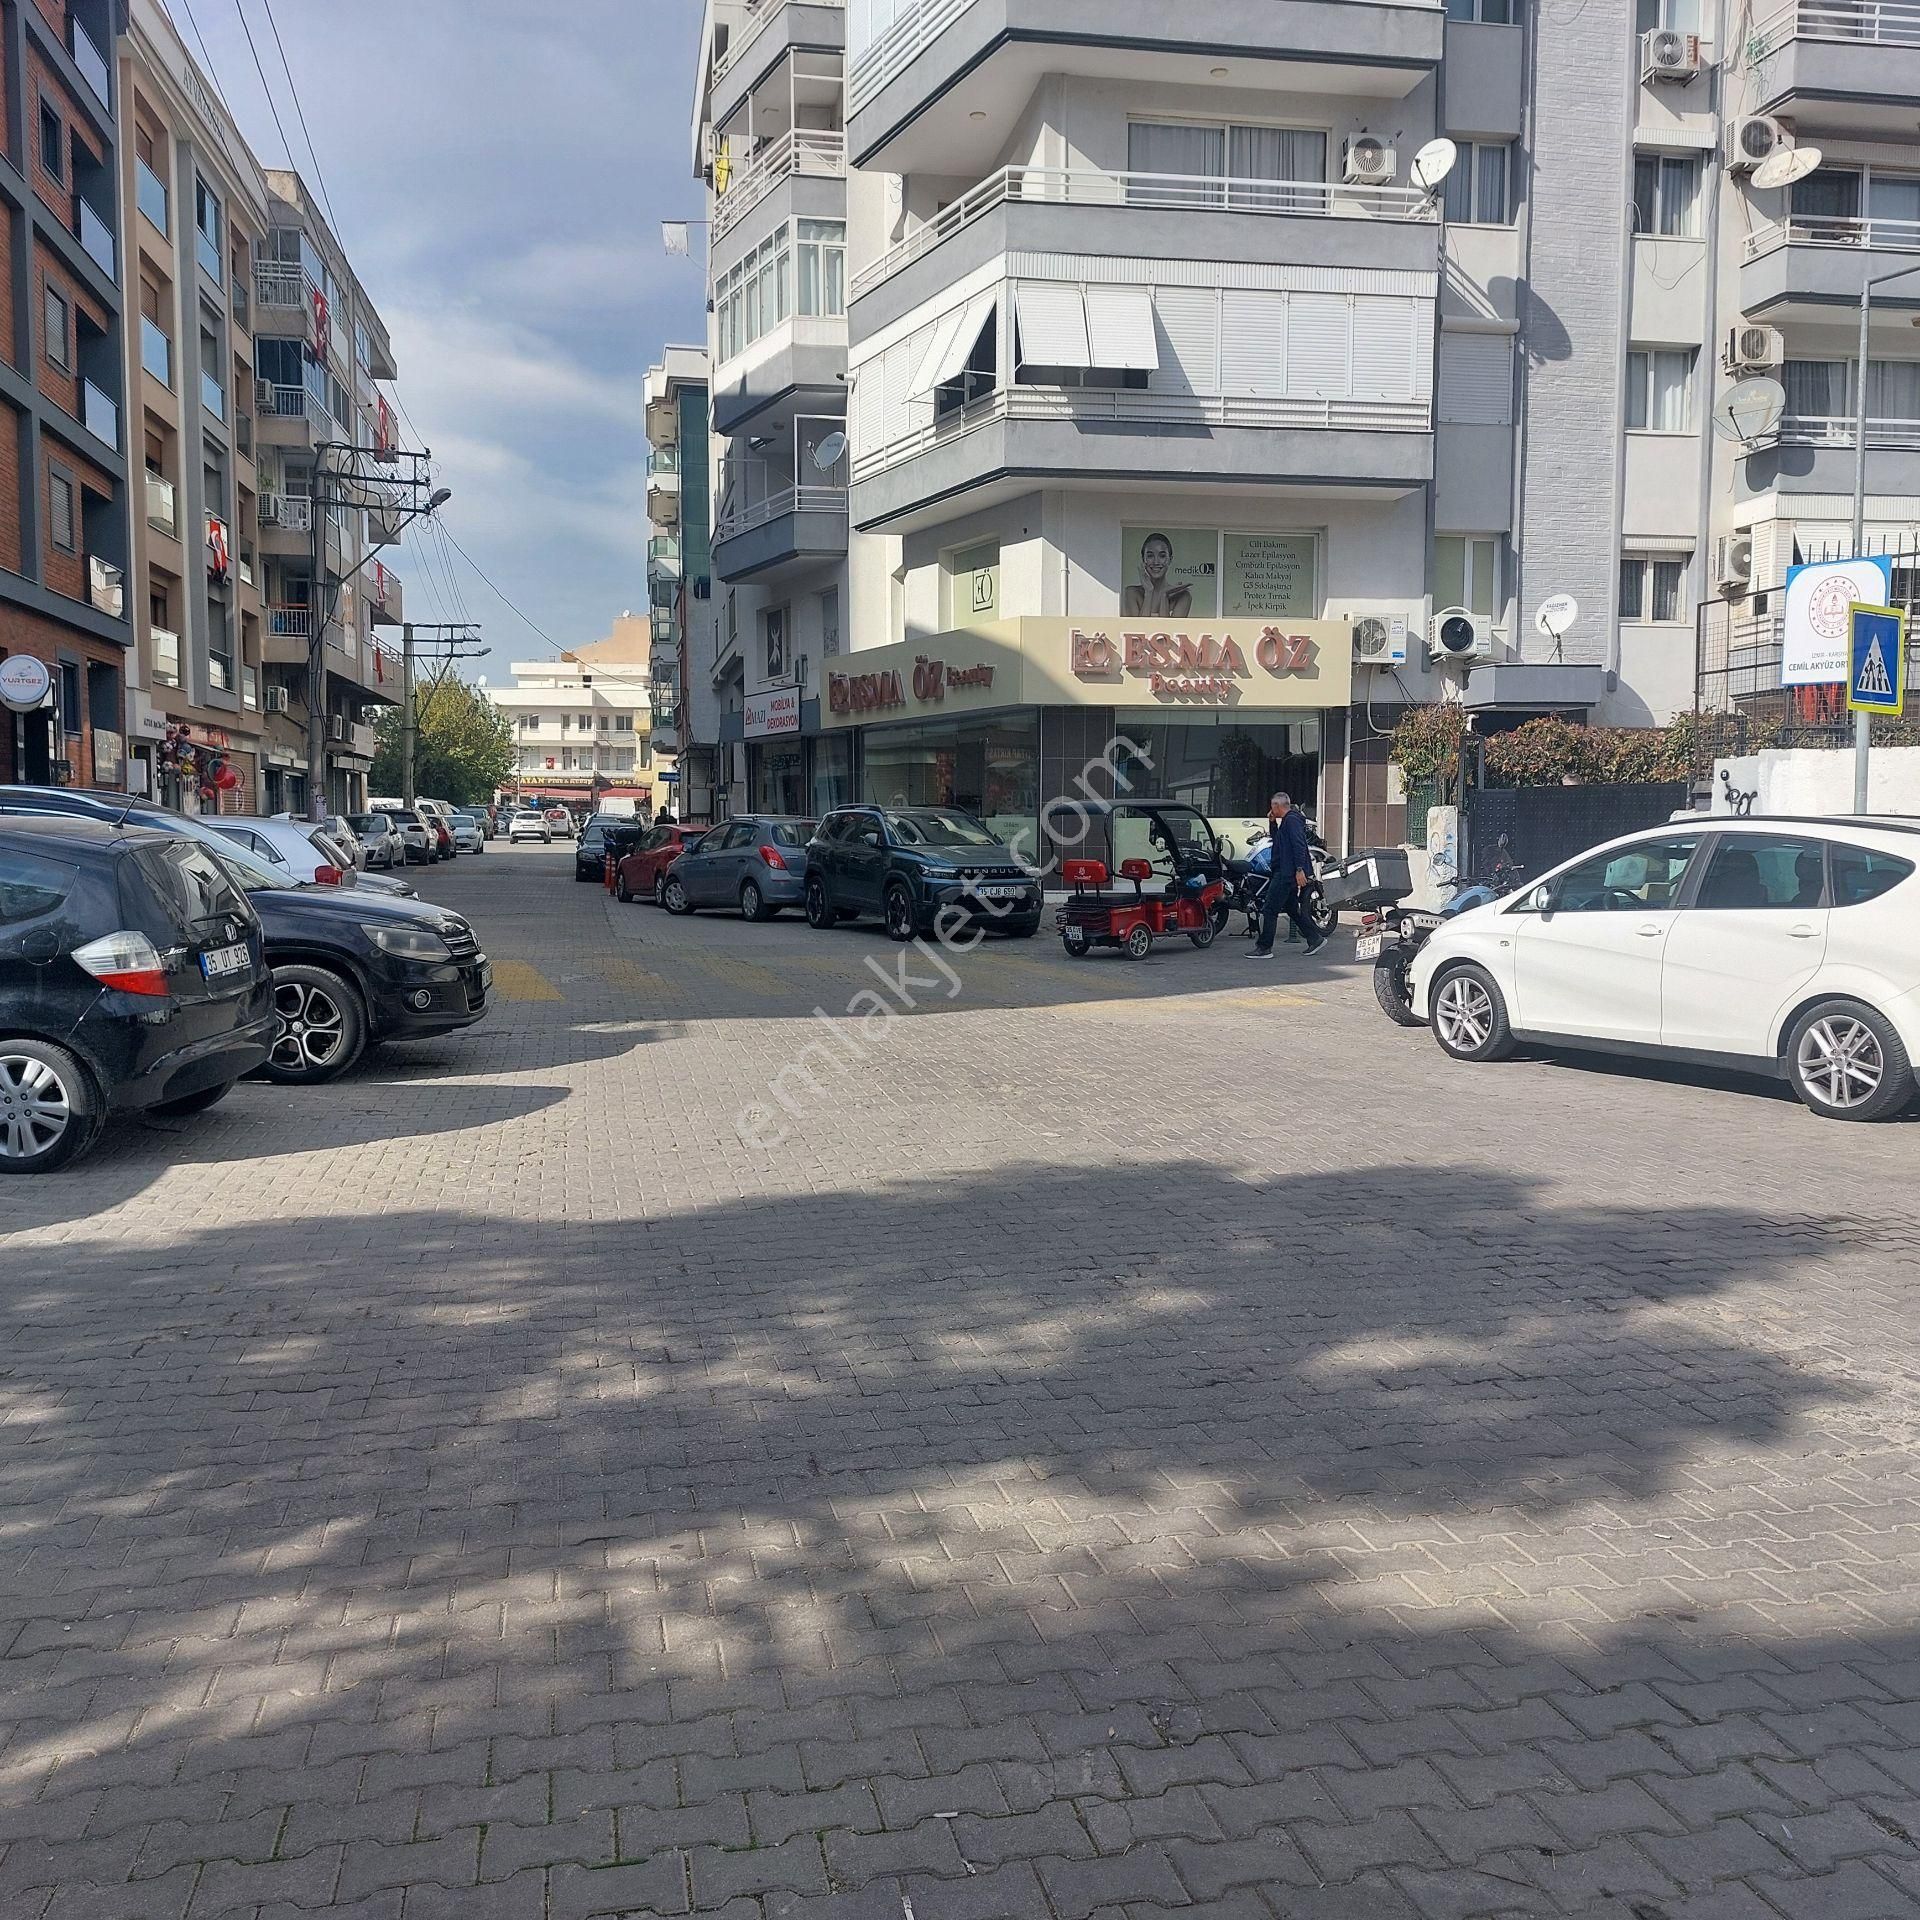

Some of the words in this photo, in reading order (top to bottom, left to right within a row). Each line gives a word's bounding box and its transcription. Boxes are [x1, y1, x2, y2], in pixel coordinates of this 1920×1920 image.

[1262, 551, 1296, 560] Epilasyon
[1266, 562, 1301, 571] Epilasyon
[1266, 572, 1292, 582] Makyaj
[1244, 591, 1266, 600] Protez
[1268, 592, 1291, 600] Tırnak
[1265, 602, 1287, 612] Kirpik
[1123, 633, 1243, 668] ESMA
[1256, 627, 1310, 670] ÖZ
[1788, 661, 1809, 671] CEMİL
[1810, 659, 1834, 670] AKYÜZ
[1835, 660, 1848, 669] ORT
[1, 676, 43, 685] YURTGEZ
[850, 670, 907, 709] ESMA
[913, 655, 945, 700] ÖZ
[1150, 673, 1231, 699] Beauty
[770, 696, 790, 711] MOBİLYA
[767, 713, 799, 730] DEKORASYON
[980, 888, 988, 896] 35
[1359, 940, 1367, 948] 35
[206, 954, 218, 973] 35
[220, 950, 232, 968] UT
[233, 946, 249, 965] 926
